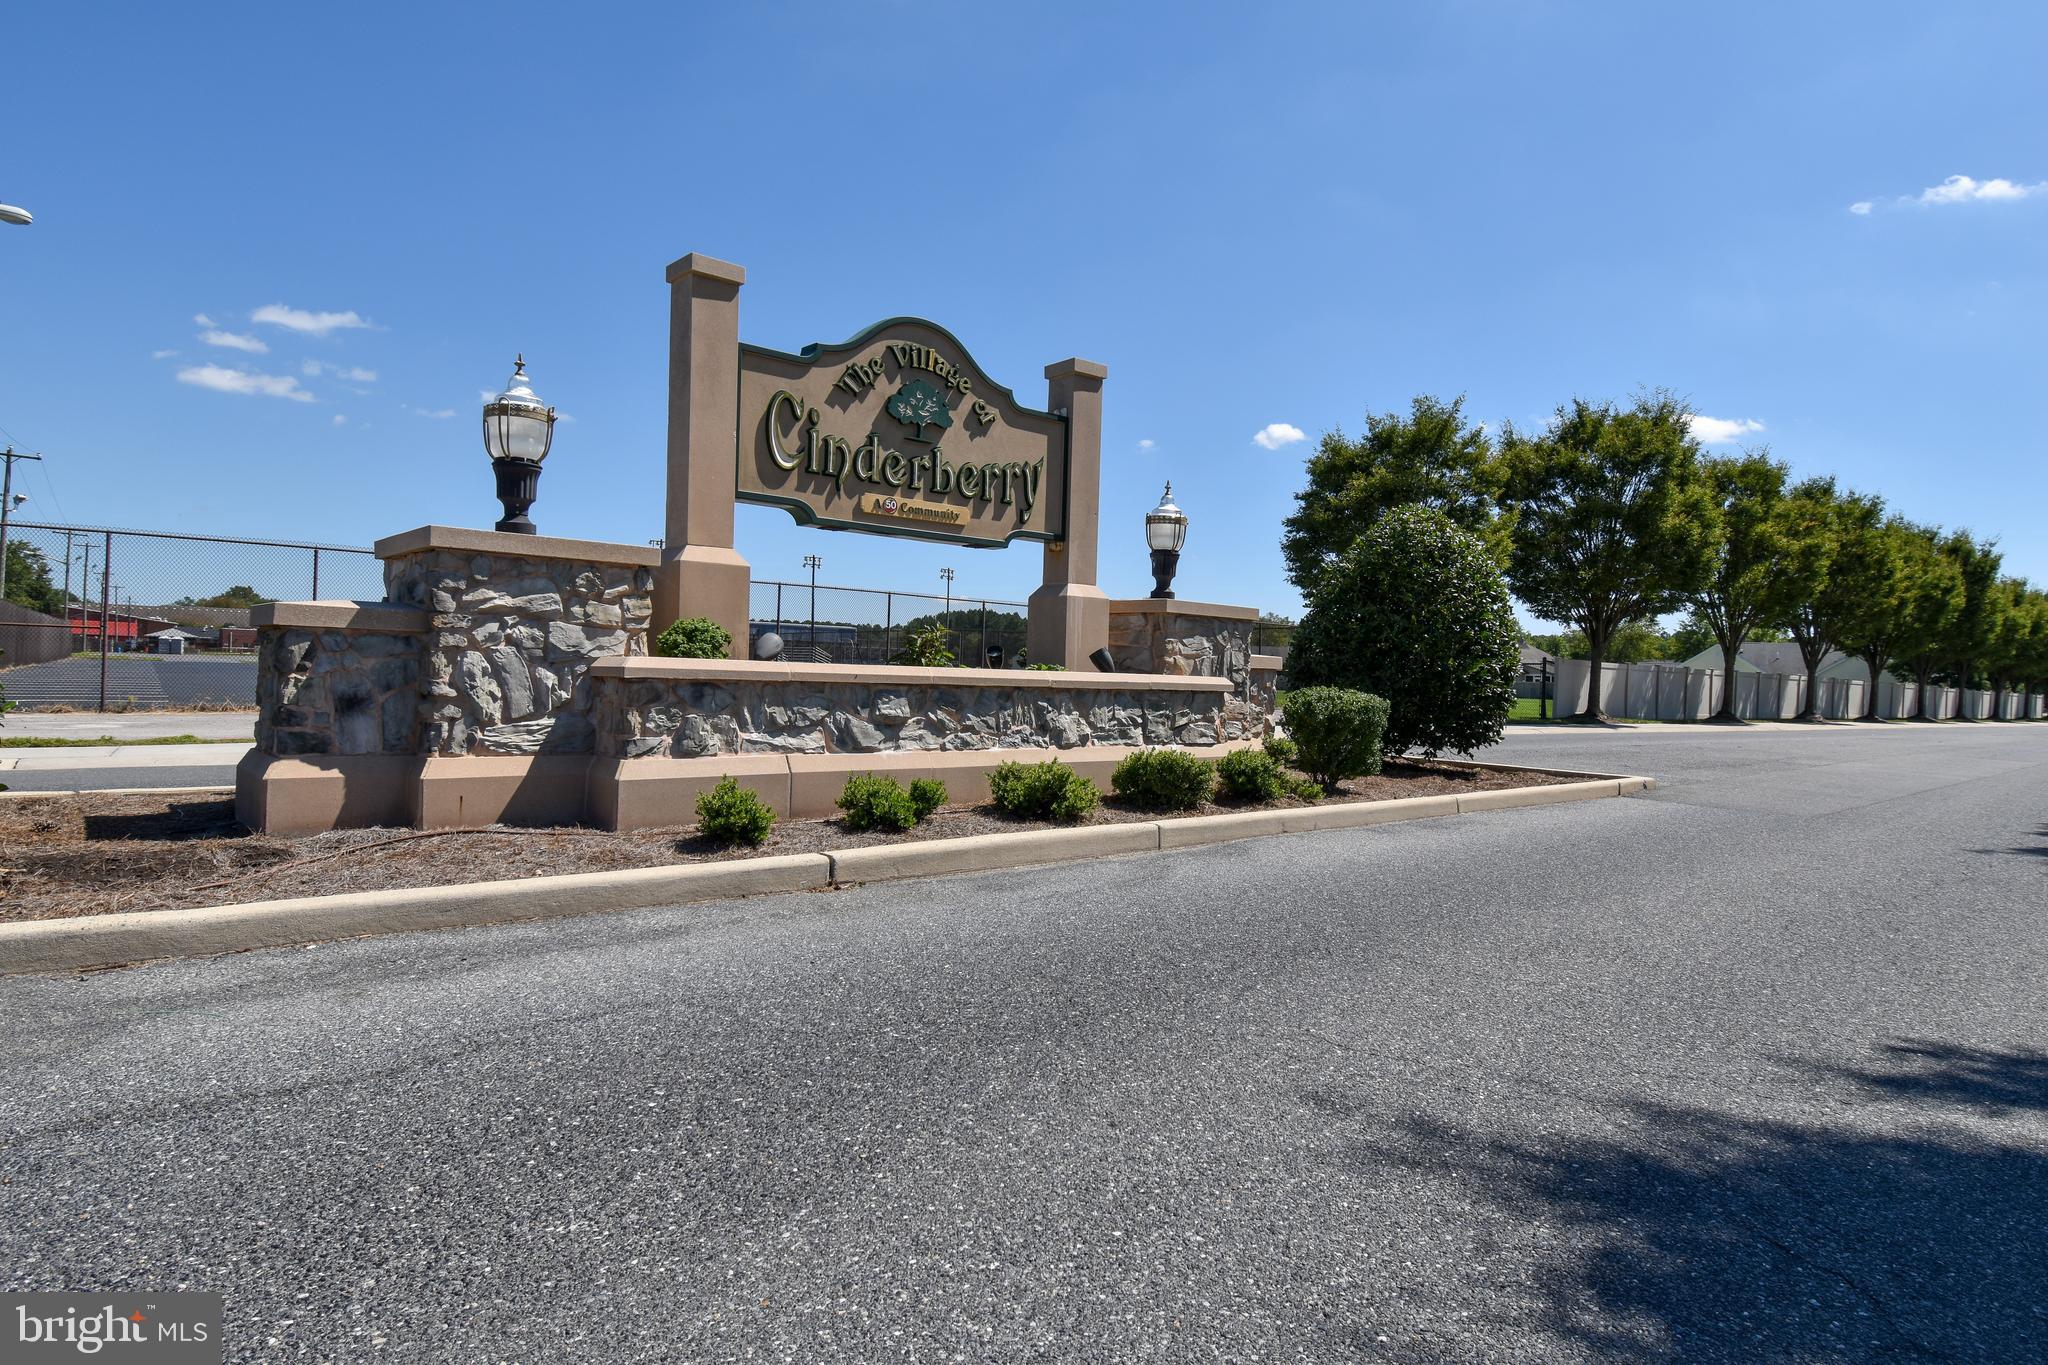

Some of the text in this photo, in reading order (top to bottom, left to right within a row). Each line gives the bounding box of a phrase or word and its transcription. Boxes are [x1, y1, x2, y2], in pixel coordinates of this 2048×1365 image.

[832, 355, 886, 398] The
[886, 343, 973, 395] Village
[766, 389, 1044, 523] Cinderberry
[900, 502, 960, 523] Community
